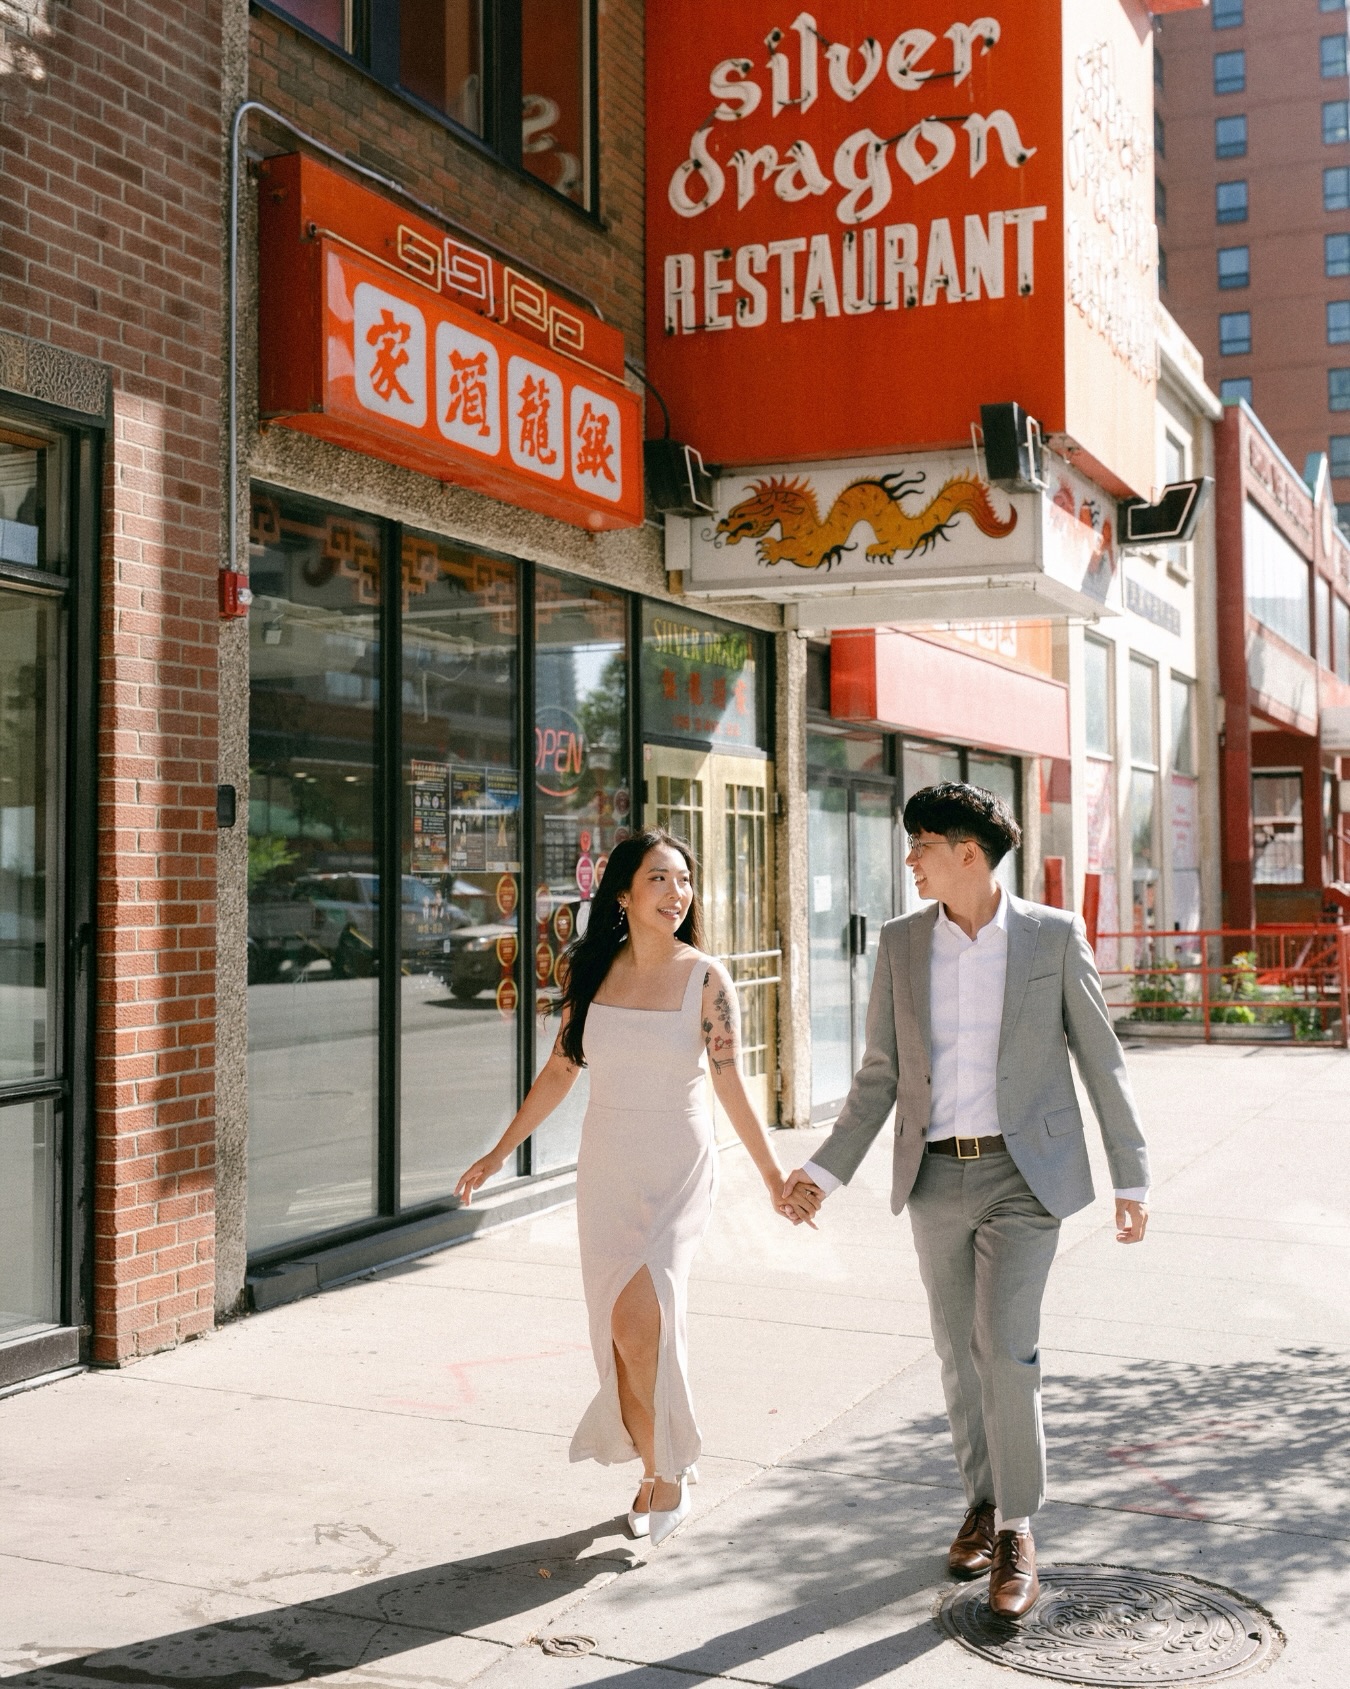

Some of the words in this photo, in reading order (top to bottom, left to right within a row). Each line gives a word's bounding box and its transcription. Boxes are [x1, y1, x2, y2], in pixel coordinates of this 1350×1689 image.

[709, 12, 1000, 121] silver
[668, 110, 1036, 224] dragon
[664, 206, 1047, 336] RESTAURANT
